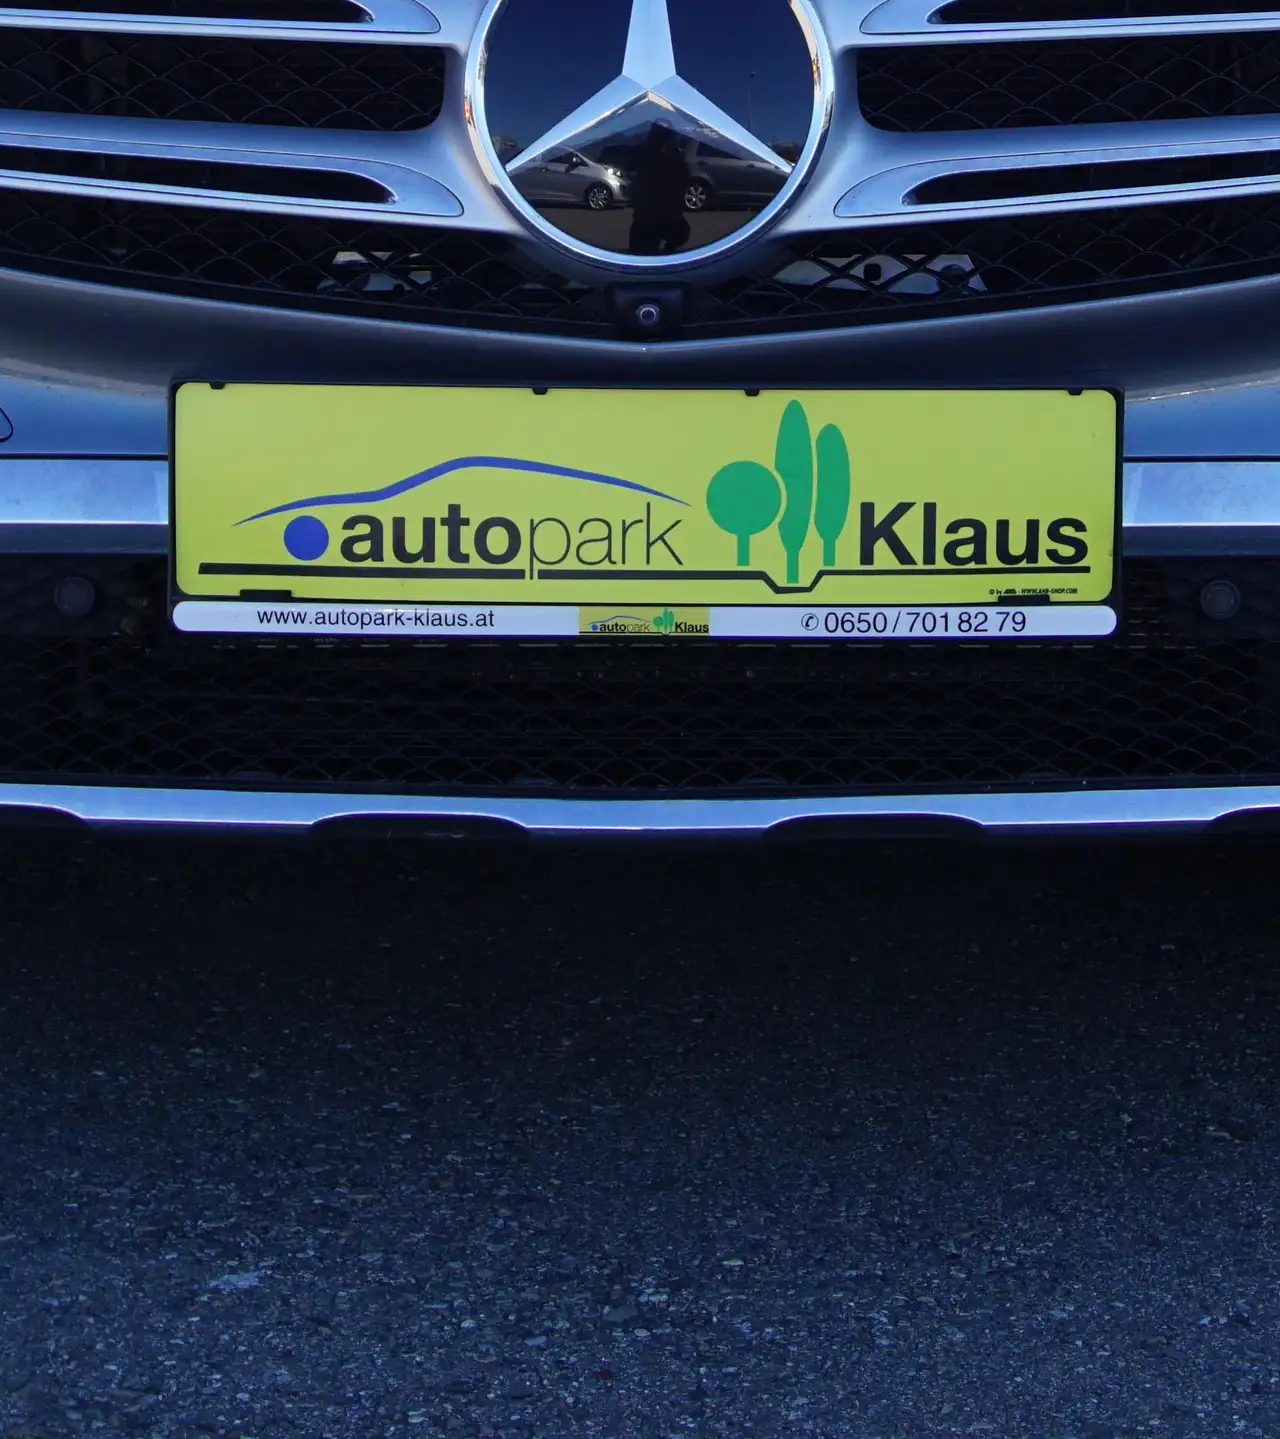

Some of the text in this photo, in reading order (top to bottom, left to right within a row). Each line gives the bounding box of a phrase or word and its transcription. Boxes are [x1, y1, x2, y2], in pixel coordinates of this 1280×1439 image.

[340, 502, 1089, 580] autopark Klaus
[256, 609, 495, 630] www.autopark-klaus.at
[599, 621, 709, 633] autopark Klaus
